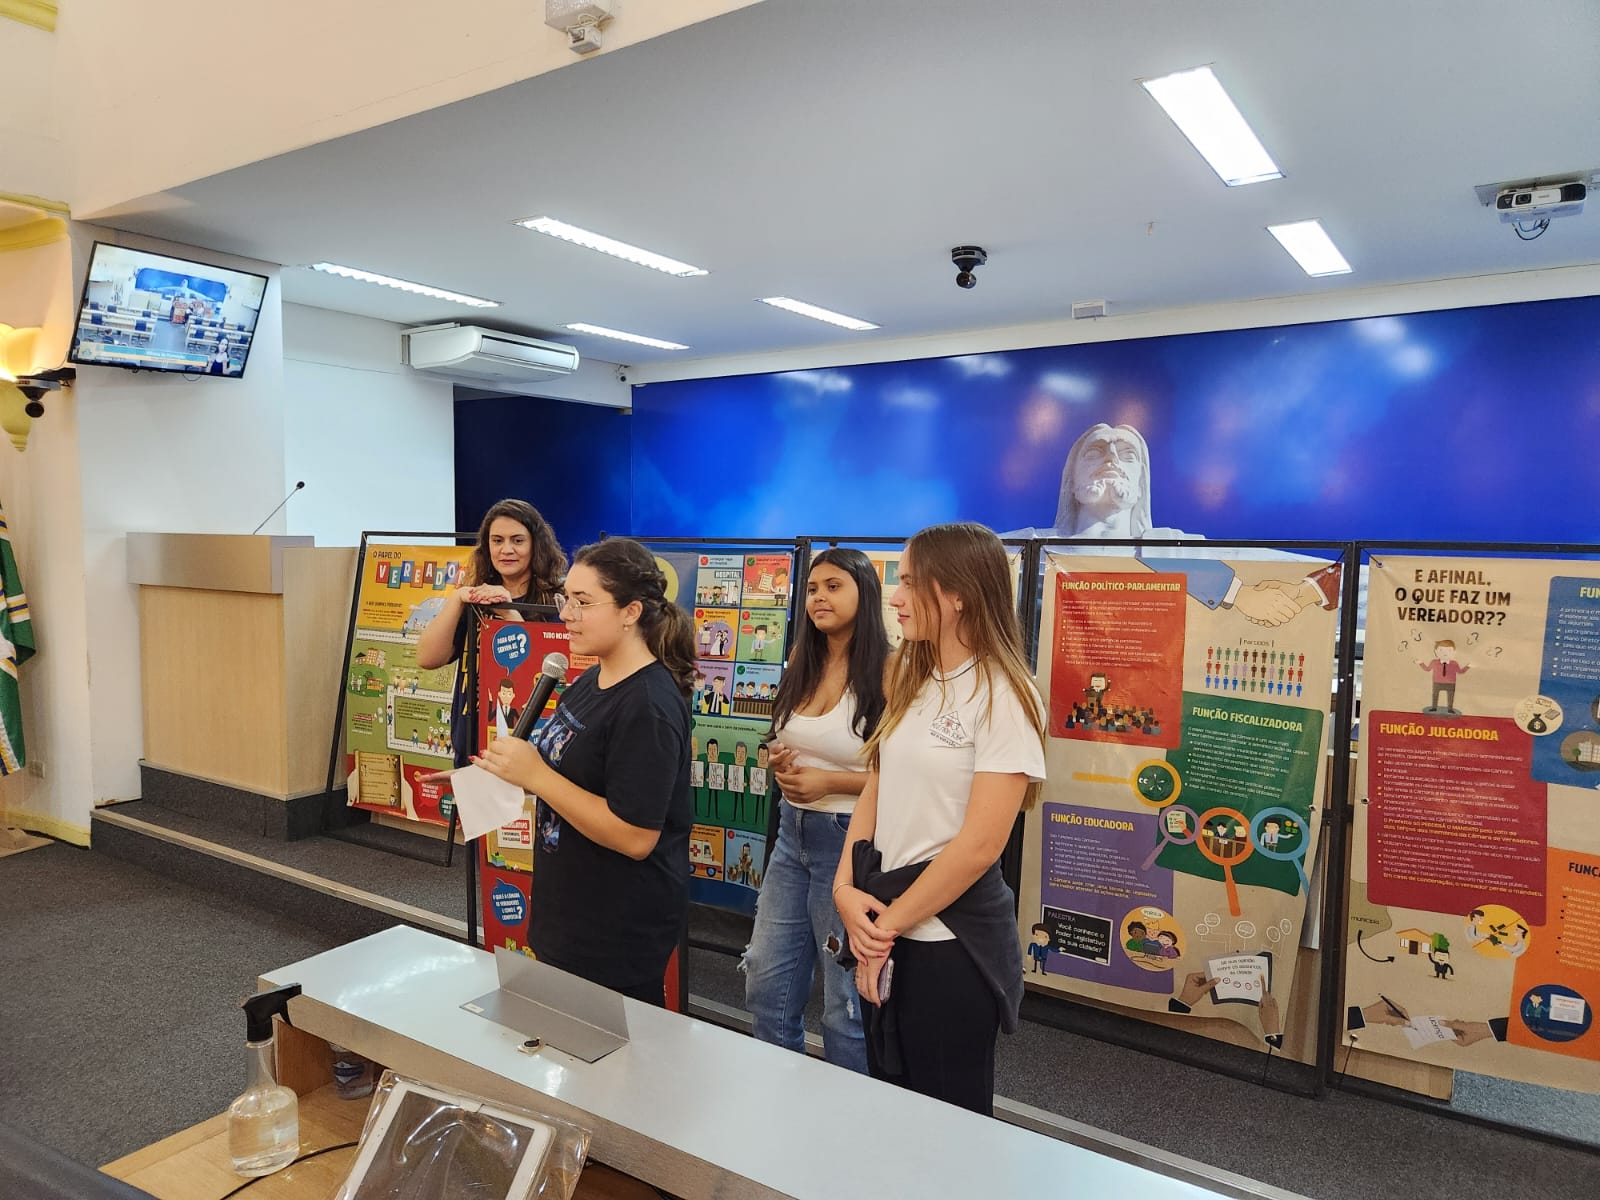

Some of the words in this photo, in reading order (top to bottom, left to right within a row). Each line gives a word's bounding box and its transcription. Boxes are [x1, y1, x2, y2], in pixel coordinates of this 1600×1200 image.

[1415, 569, 1423, 583] E
[1062, 580, 1090, 591] FUNÇÃO
[1091, 581, 1181, 592] POLÍTICO-PARLAMENTAR
[1395, 587, 1407, 602] O
[1412, 588, 1445, 604] QUE
[1449, 590, 1480, 604] FAZ
[1485, 591, 1511, 606] UM
[1397, 607, 1506, 626] VEREADOR??
[1192, 706, 1228, 720] FUNÇÃO
[1230, 712, 1302, 732] FISCALIZADORA
[1380, 722, 1424, 736] FUNÇÃO
[1428, 726, 1498, 741] JULGADORA
[1051, 813, 1082, 825] FUNÇÃO
[1084, 817, 1134, 832] EDUCADORA
[1048, 911, 1076, 922] PALESTRA
[1056, 930, 1071, 938] Poder
[1073, 933, 1106, 947] Legislativo
[1074, 927, 1099, 938] conhece
